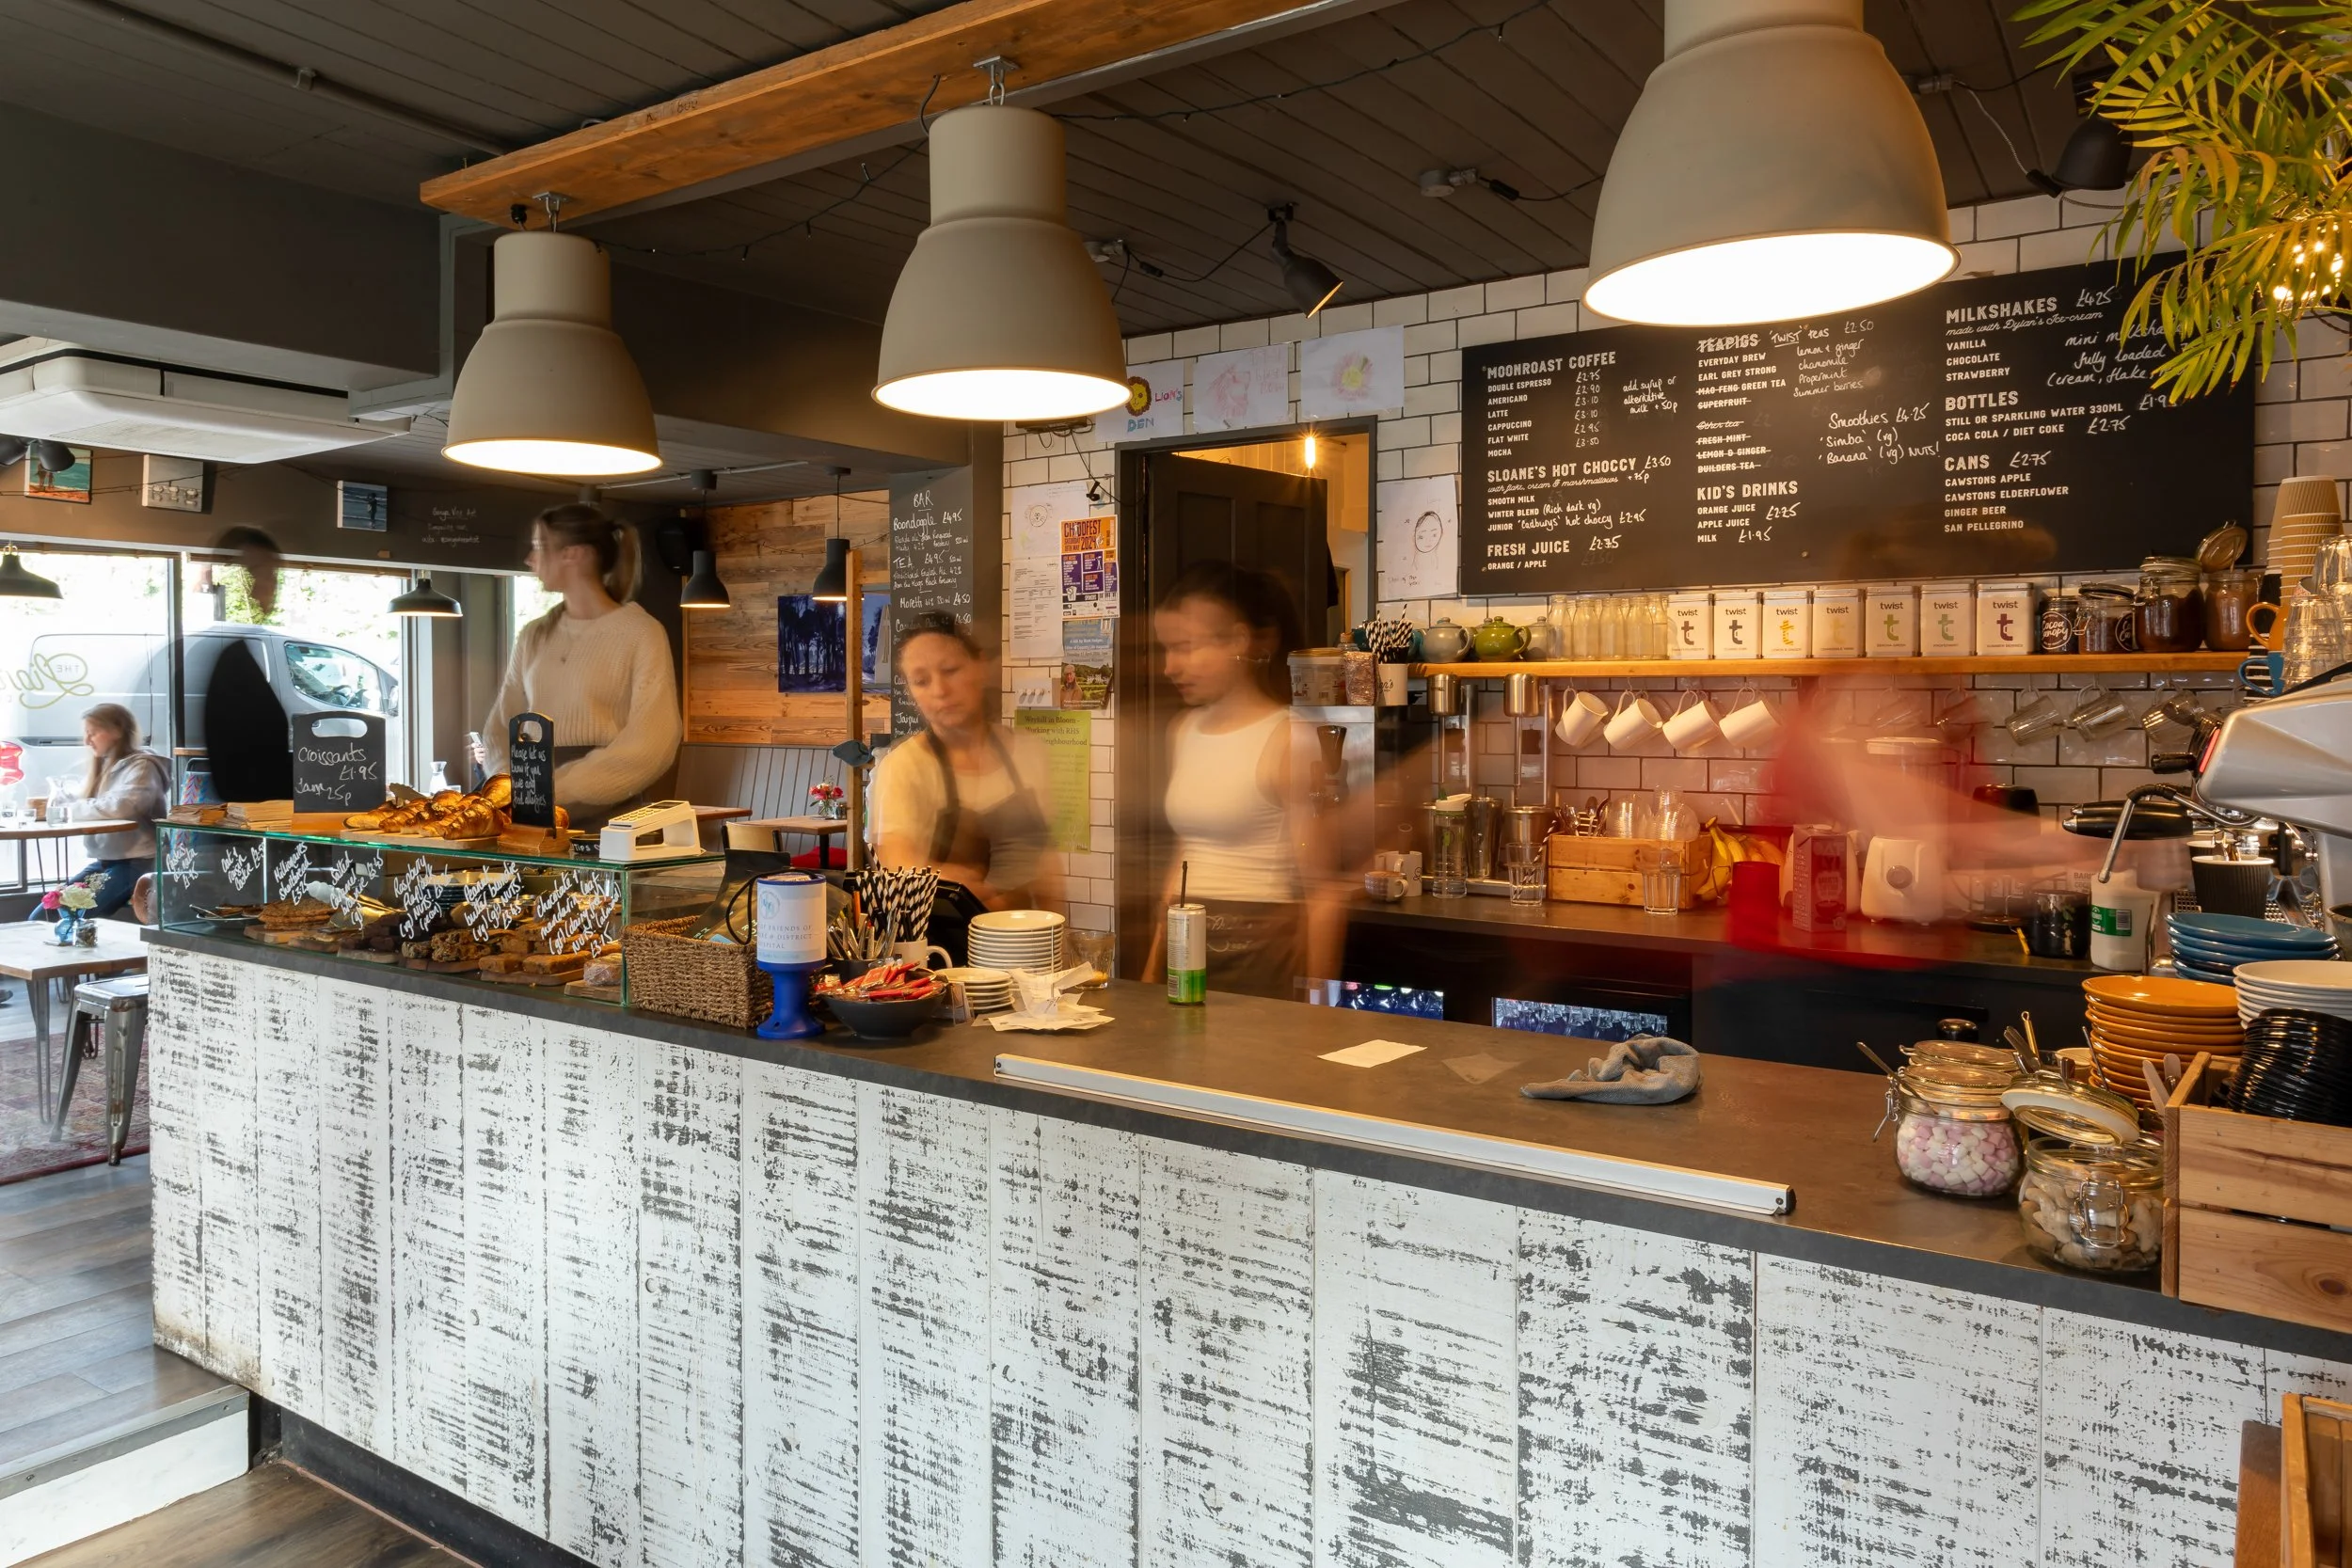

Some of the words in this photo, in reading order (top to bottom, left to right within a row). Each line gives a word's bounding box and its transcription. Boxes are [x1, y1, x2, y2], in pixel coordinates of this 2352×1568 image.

[1946, 296, 2058, 325] MILKSHAKES
[1946, 326, 1975, 336] made
[1977, 322, 2000, 333] with
[1697, 334, 1760, 353] TEAPIGS
[1947, 339, 1987, 351] VANILLA
[2065, 331, 2099, 347] mini
[1836, 339, 1865, 357] ginger
[2115, 343, 2167, 362] loaded
[1487, 358, 1563, 379] MOONROAST
[1568, 352, 1616, 369] COFFEE
[1698, 356, 1739, 368] EVERYDAY
[1742, 353, 1766, 362] BREW
[1947, 353, 2000, 367] CHOCOLATE
[1698, 372, 1718, 381] EARL
[1722, 370, 1741, 378] GREY
[1745, 366, 1776, 376] STRONG
[1946, 367, 2010, 382] STRAWBERRY
[1487, 383, 1514, 392] DOUBLE
[1517, 378, 1552, 389] ESPRESSO
[1576, 385, 1600, 395] £2.90
[1623, 379, 1639, 391] add
[1741, 381, 1768, 391] GREEN
[1771, 379, 1787, 388] TEA
[1487, 394, 1528, 405] AMERICANO
[1697, 397, 1749, 409] SUPERFRUIT
[1946, 390, 2019, 412] BOTTLES
[1487, 409, 1508, 419] LATTE
[1829, 409, 1889, 429] Smoothies
[1896, 402, 1930, 422] £4.25
[1946, 416, 1971, 426] STILL
[1975, 414, 1987, 424] OR
[1992, 410, 2046, 422] SPARKLING
[2051, 406, 2085, 417] WATER
[2090, 404, 2123, 414] 330ML
[1128, 417, 1154, 433] DEN
[1487, 420, 1533, 432] CAPPUCCINO
[2087, 415, 2131, 435] £2.75
[1487, 436, 1504, 444] FLAT
[1507, 434, 1529, 442] WHITE
[1697, 436, 1723, 445] FRESH
[1725, 434, 1748, 443] MINT
[1946, 432, 1970, 442] COCA
[1975, 430, 1998, 439] COLA
[2013, 427, 2034, 436] DIET
[2039, 424, 2065, 434] COKE
[1487, 449, 1512, 457] MOCHA
[1697, 451, 1724, 459] LEMON
[1737, 447, 1768, 456] GINGER
[2010, 451, 2052, 468] £2.75
[1697, 463, 1737, 473] BUILDERS
[1945, 454, 1990, 471] CANS
[1487, 466, 1546, 483] SLOANE'S
[1552, 463, 1577, 478] HOT
[1582, 457, 1637, 475] CHOCCY
[1527, 482, 1550, 490] cream
[1562, 476, 1618, 487] marshmallows
[1946, 476, 1996, 487] CAWSTONS
[2000, 473, 2031, 483] APPLE
[1697, 484, 1735, 500] KID'S
[1741, 481, 1798, 498] DRINKS
[1946, 491, 1995, 502] CAWSTONS
[2000, 486, 2069, 499] ELDERFLOWER
[914, 490, 934, 508] BAR
[1487, 497, 1516, 506] SMOOTH
[1518, 495, 1535, 503] MILK
[1487, 510, 1515, 518] WINTER
[1517, 508, 1539, 516] BLEND
[1697, 505, 1728, 515] ORANGE
[1731, 504, 1756, 513] JUICE
[1945, 508, 1978, 517] GINGER
[1982, 506, 2007, 515] BEER
[1487, 523, 1513, 531] JUNIOR
[1697, 520, 1723, 529] APPLE
[1725, 518, 1750, 527] JUICE
[1945, 524, 1963, 533] SAN
[1967, 520, 2025, 532] PELLEGRINO
[1697, 534, 1717, 543] MILK
[1739, 526, 1772, 543] £1.95
[1487, 543, 1526, 557] FRESH
[1532, 540, 1570, 555] JUICE
[1487, 562, 1515, 570] ORANGE
[1524, 560, 1547, 568] APPLE
[1826, 606, 1850, 614] twist
[1933, 601, 1959, 610] twist
[1993, 600, 2019, 609] twist
[340, 762, 377, 781] £1.95
[327, 784, 352, 806] 25p
